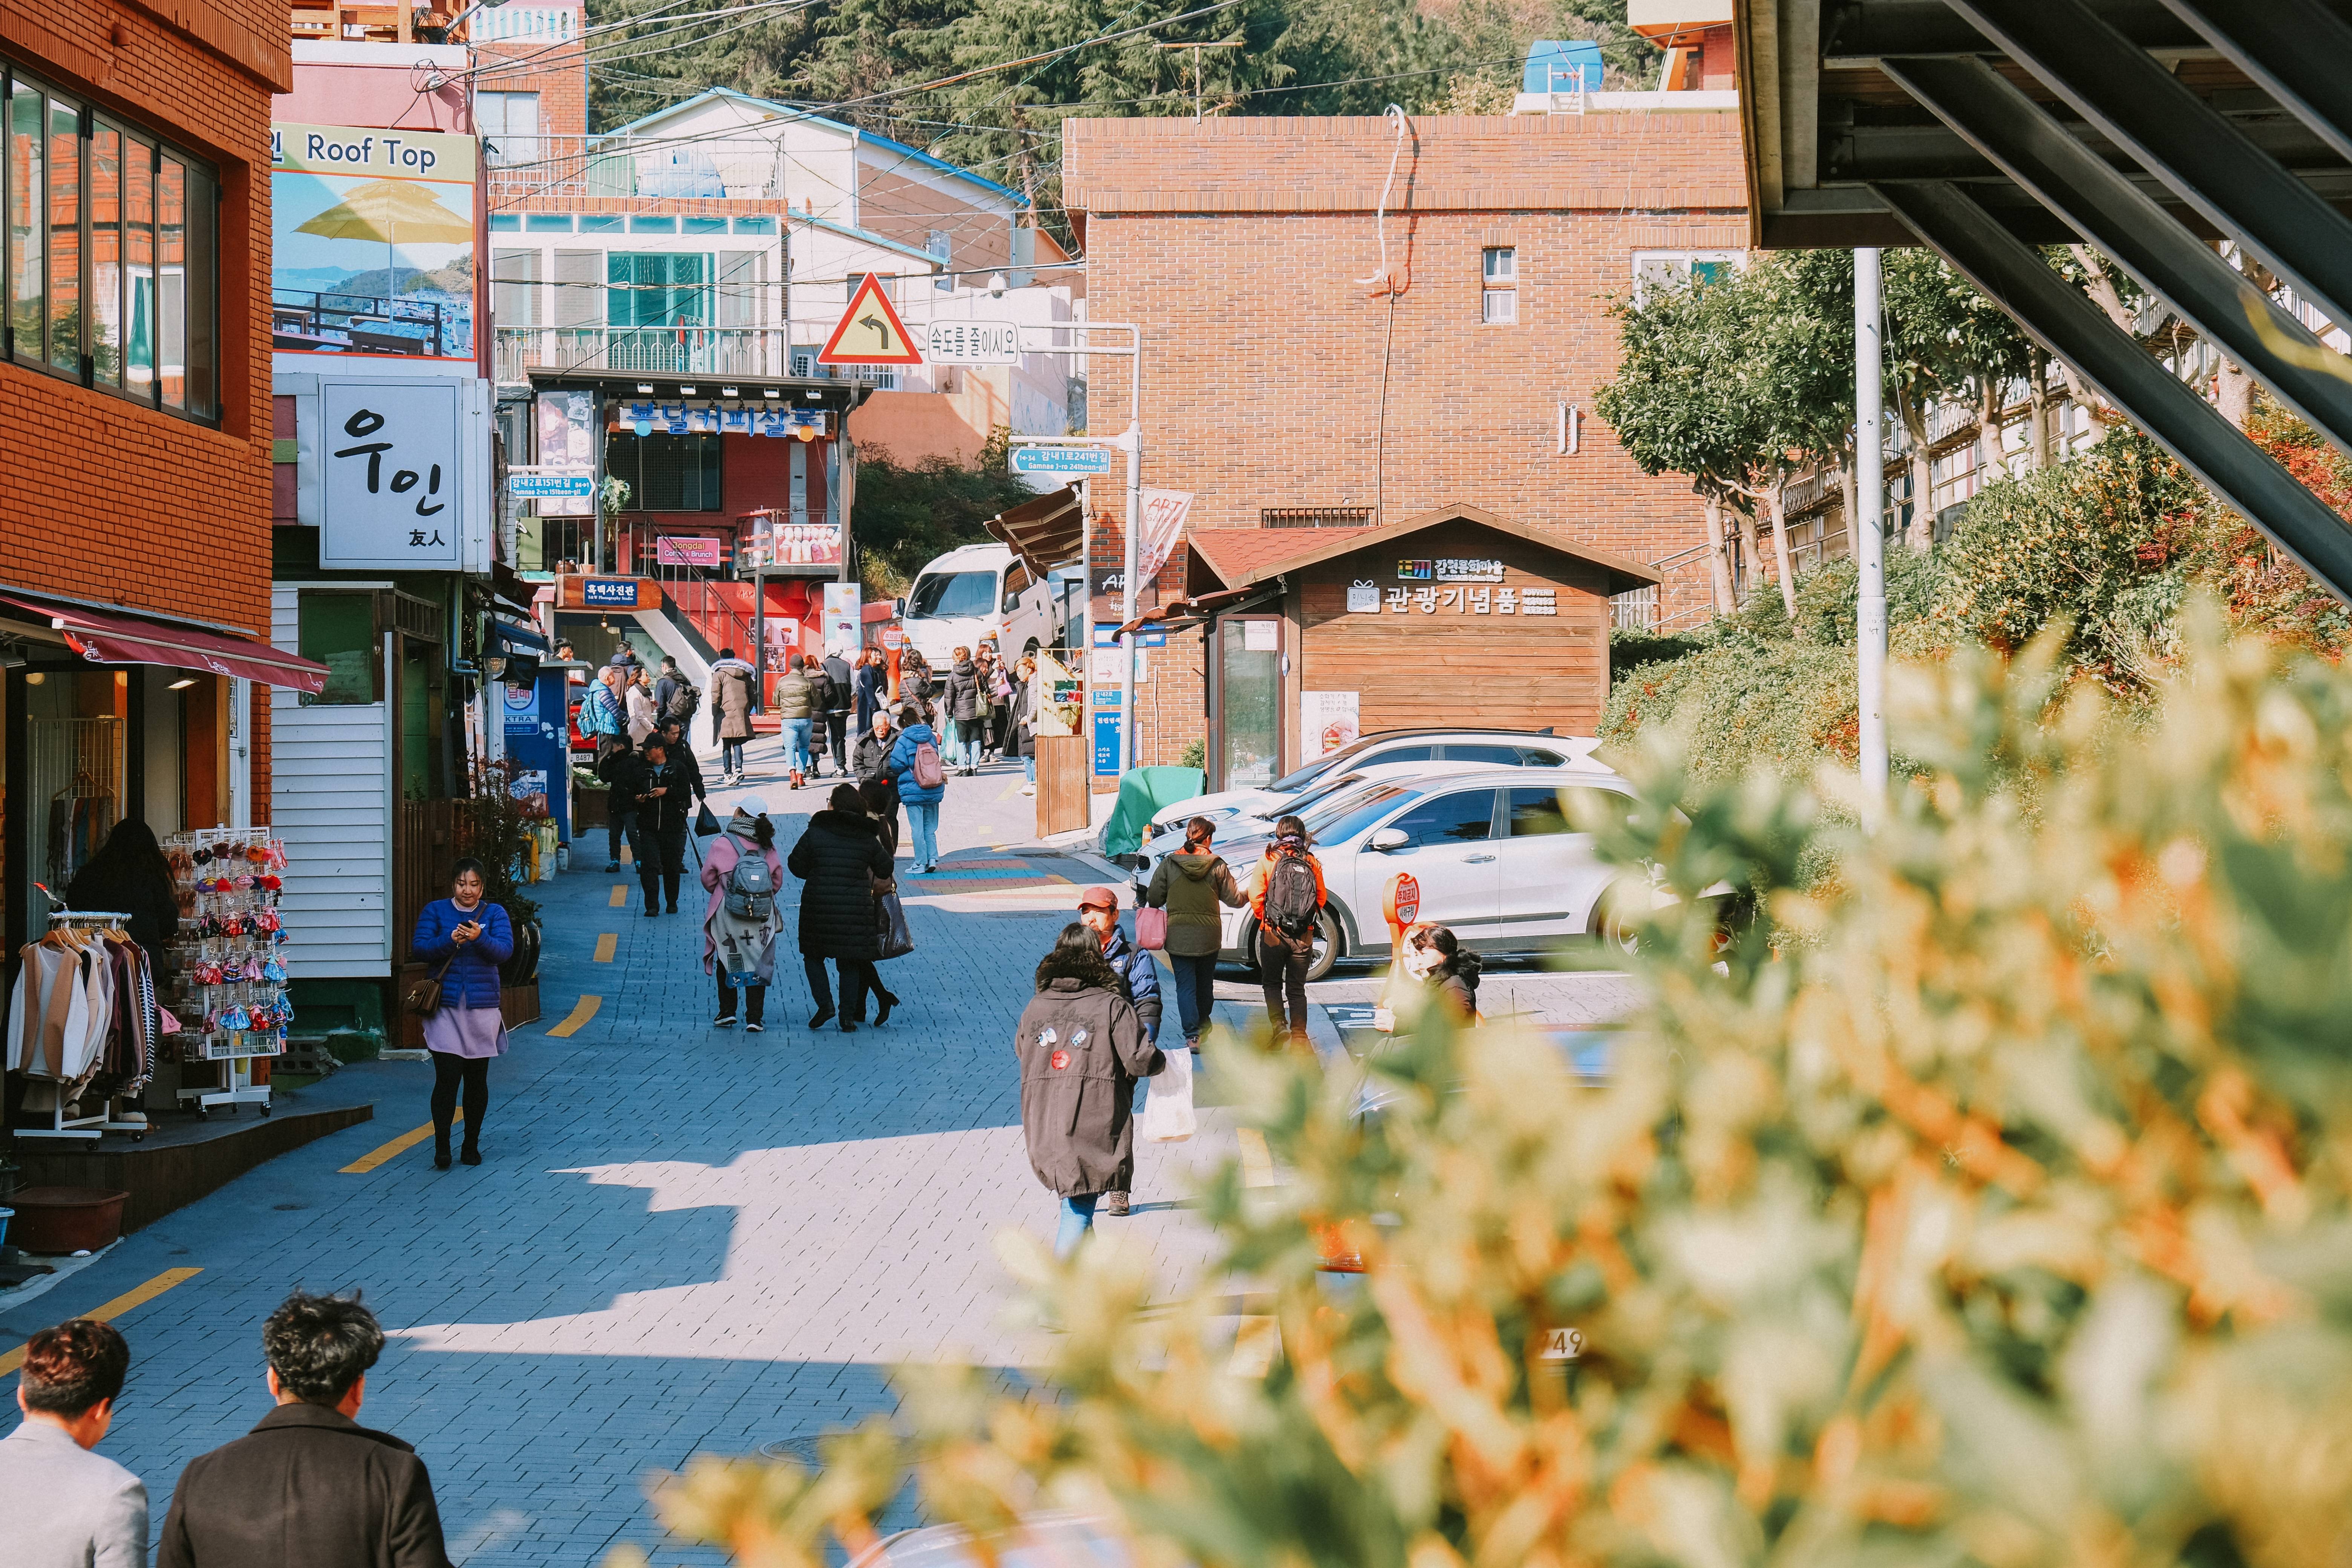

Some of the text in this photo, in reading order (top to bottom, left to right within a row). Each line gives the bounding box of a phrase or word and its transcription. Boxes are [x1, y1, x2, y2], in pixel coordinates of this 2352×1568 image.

[308, 133, 435, 173] Roof Top
[931, 327, 1014, 356] 속도를 줄이시오
[626, 402, 822, 442] 봉달커피살롱
[334, 409, 444, 516] 우인
[1147, 498, 1182, 513] ART
[409, 529, 445, 547] 友人
[587, 584, 635, 596] 흑백사진관
[1385, 586, 1519, 614] 관광기념품
[1398, 888, 1415, 902] 주차금지
[1400, 905, 1414, 918] 사하구청
